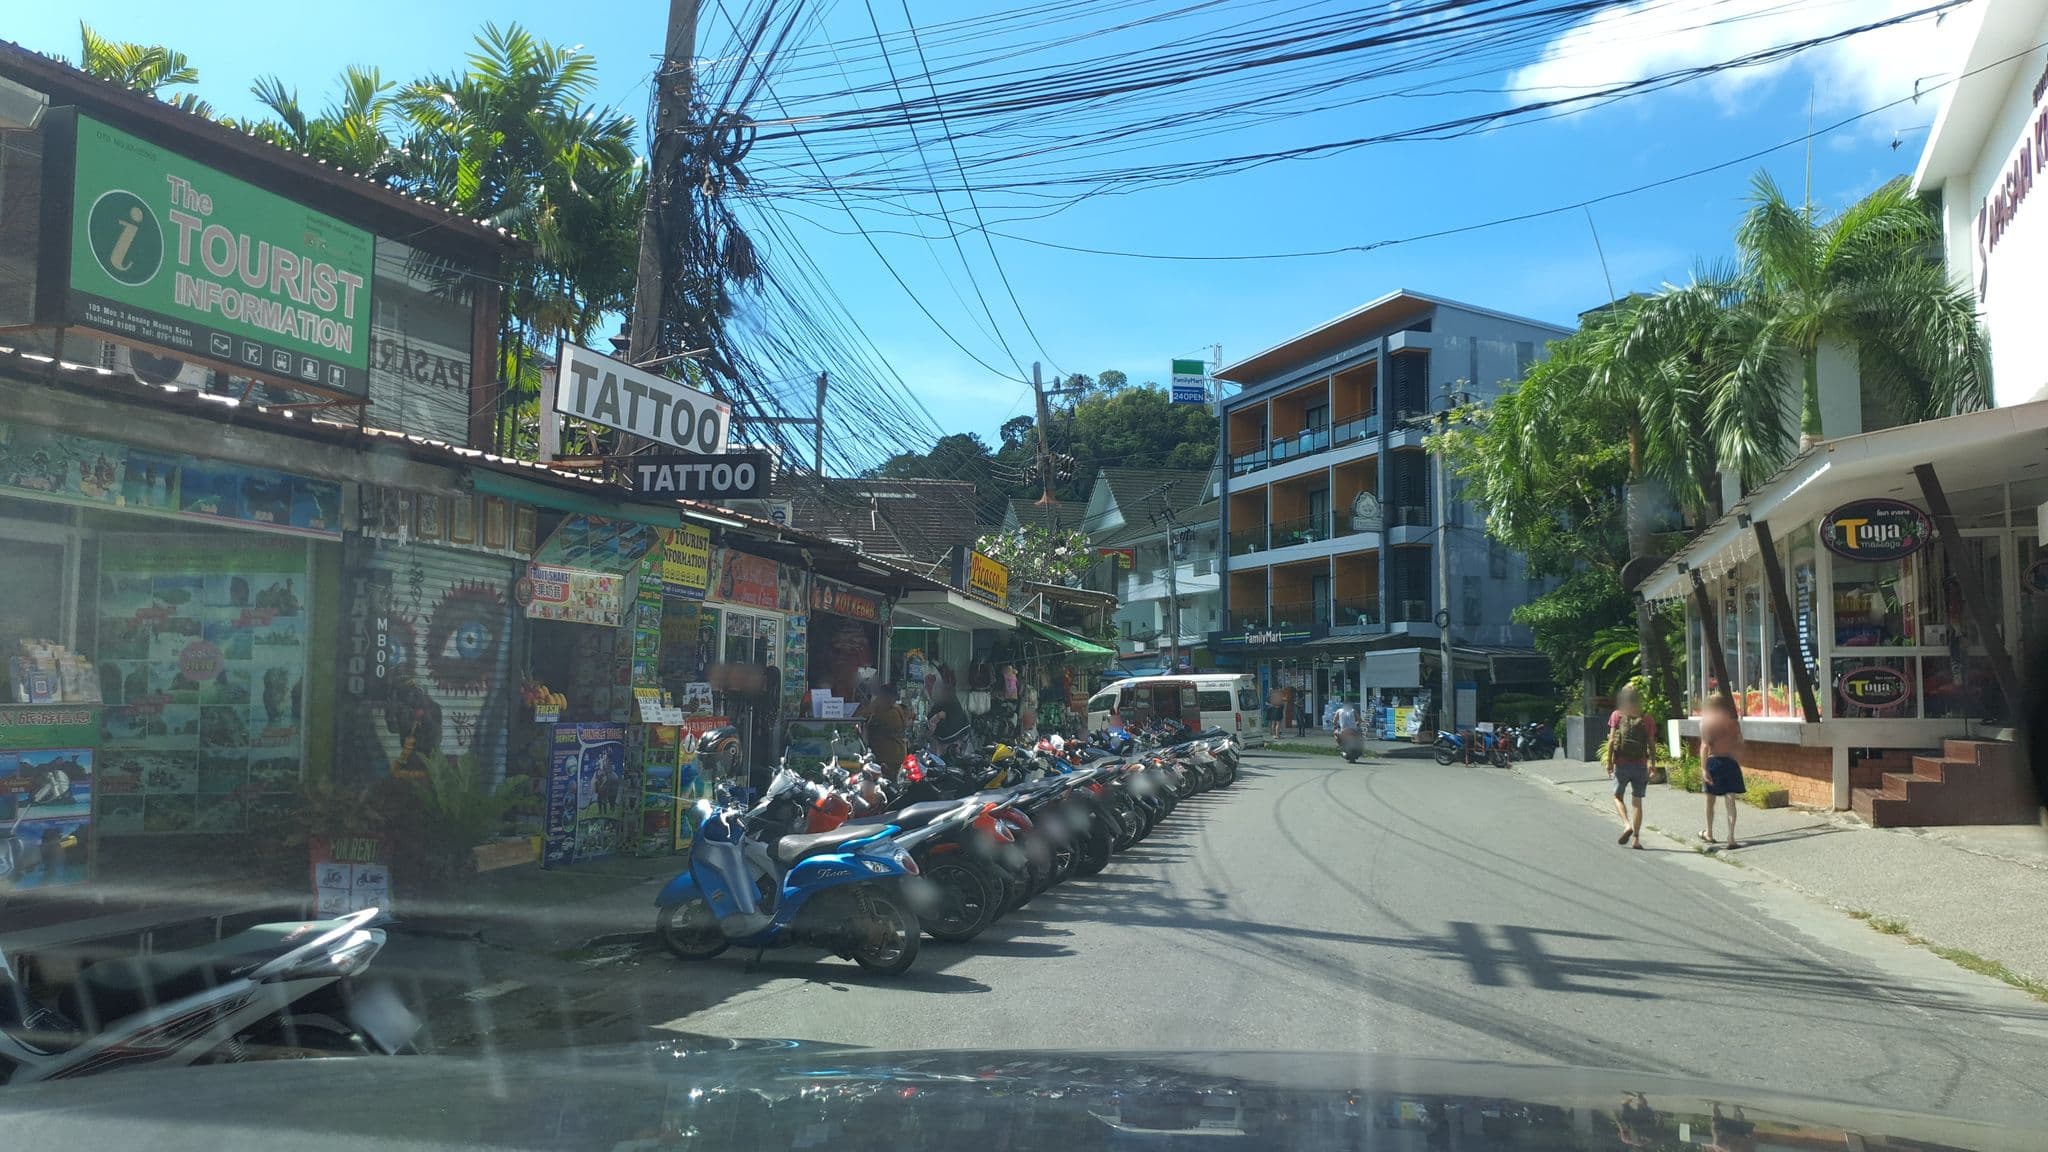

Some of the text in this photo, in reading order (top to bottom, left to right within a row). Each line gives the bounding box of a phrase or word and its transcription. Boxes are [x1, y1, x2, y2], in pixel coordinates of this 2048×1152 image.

[167, 174, 213, 215] The
[168, 210, 364, 320] TOURIST
[85, 312, 114, 327] Thailand
[174, 272, 353, 353] INFORMATION
[571, 359, 721, 453] TATTOO
[638, 463, 756, 492] TATTOO
[676, 530, 708, 551] TOURIST
[1835, 518, 1900, 549] Toya
[664, 548, 707, 569] NFORMATION
[972, 556, 1000, 592] Picasso
[1244, 631, 1283, 645] FamilyMart
[1848, 680, 1889, 697] Toya
[18, 711, 91, 726] 旅游信息
